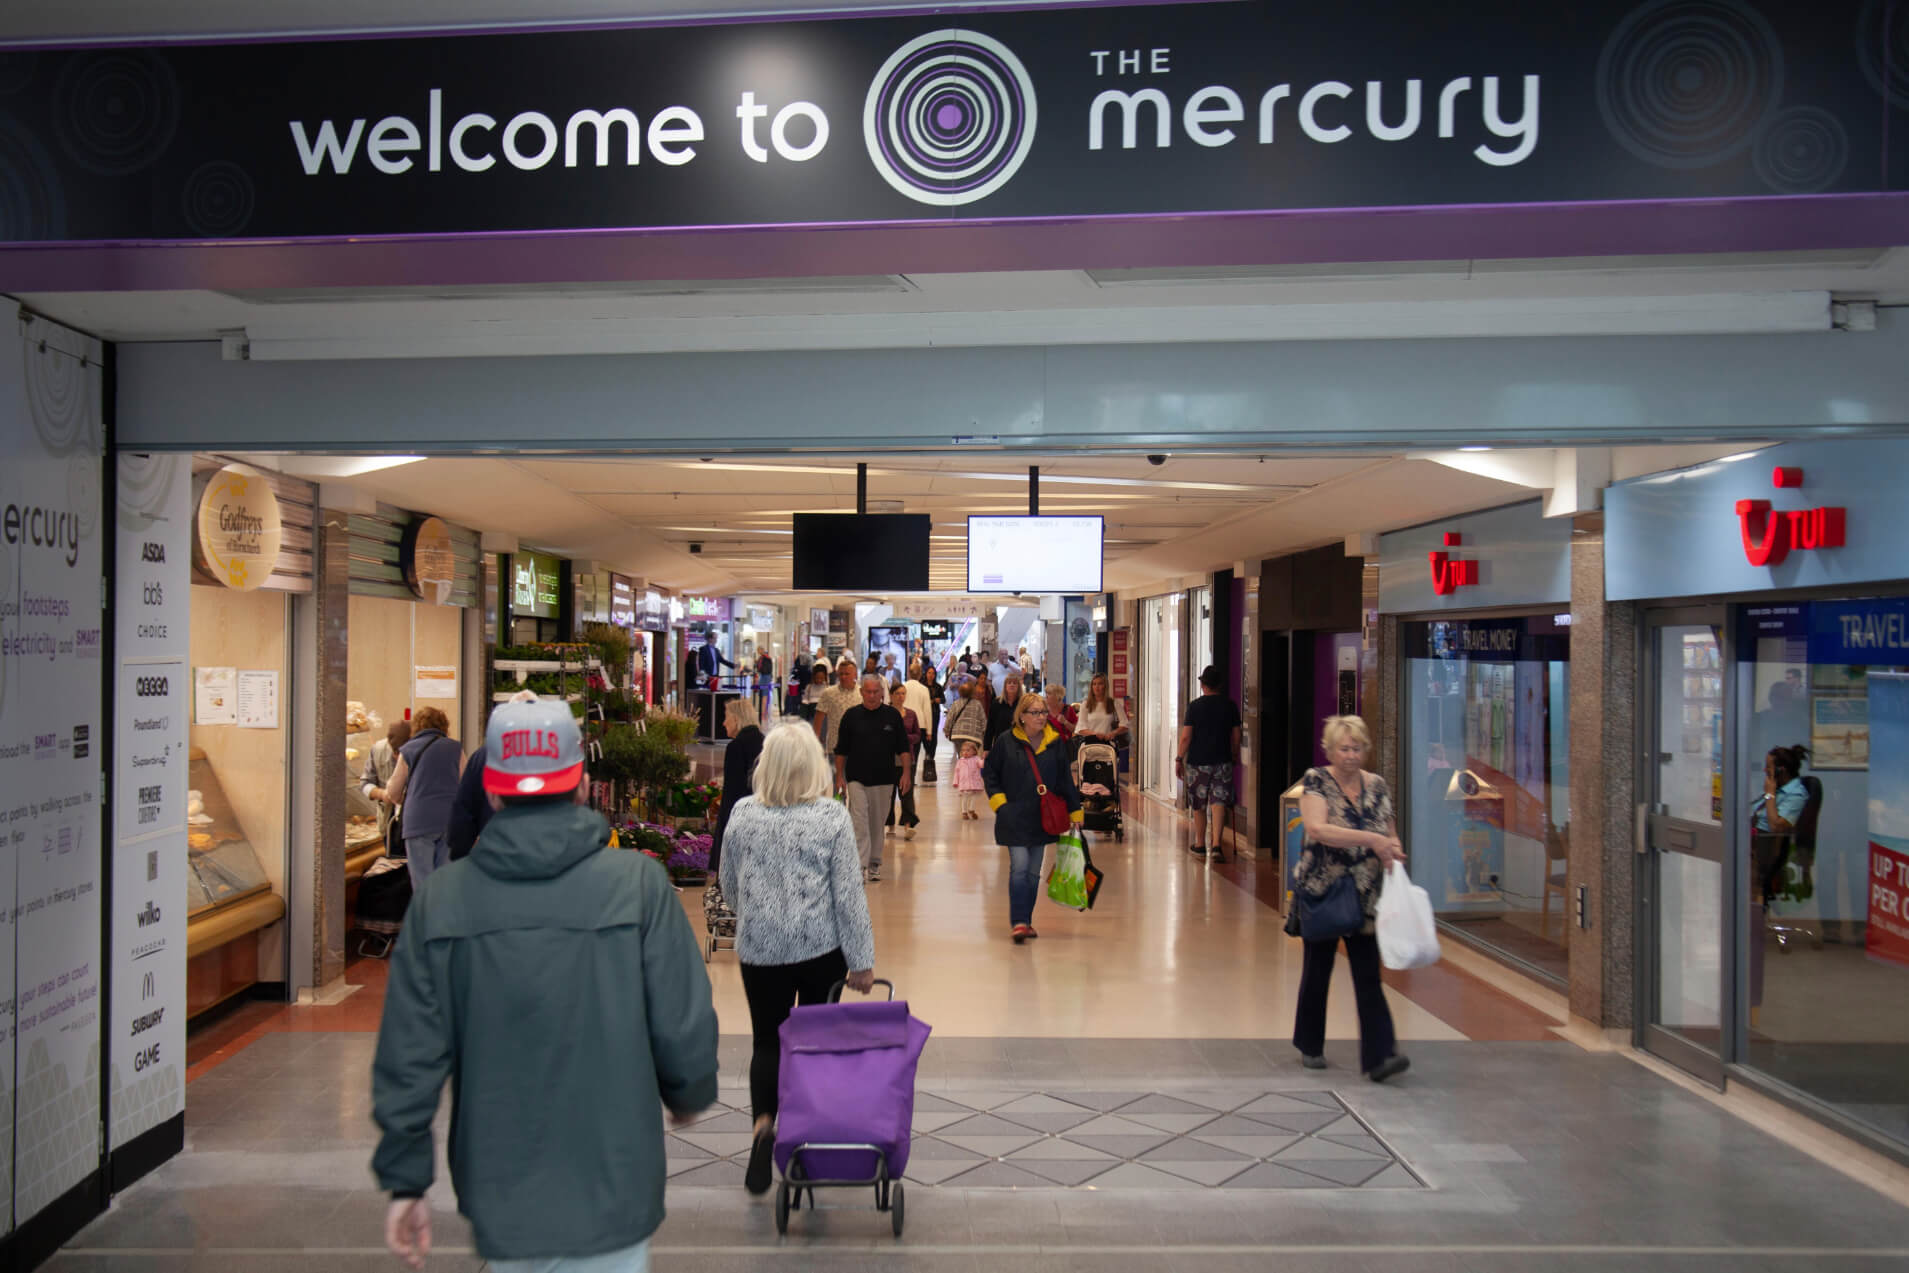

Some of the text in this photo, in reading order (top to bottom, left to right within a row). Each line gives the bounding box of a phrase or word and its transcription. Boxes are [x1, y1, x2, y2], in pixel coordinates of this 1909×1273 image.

[1090, 48, 1171, 76] THE
[289, 89, 829, 175] welcome to
[1088, 75, 1540, 167] mercury
[0, 503, 78, 568] ercury
[1787, 507, 1834, 551] TUI
[142, 541, 166, 564] ASDA
[3, 629, 57, 661] electricity
[137, 624, 168, 639] CHOICE
[1490, 628, 1517, 651] MONEY
[1839, 613, 1909, 649] TRAVEL
[502, 729, 559, 760] BULLS
[1873, 852, 1893, 880] UP
[1872, 882, 1899, 917] PER
[137, 902, 161, 928] wilko
[130, 1007, 164, 1037] SUBWAY
[134, 1043, 160, 1072] GAME
